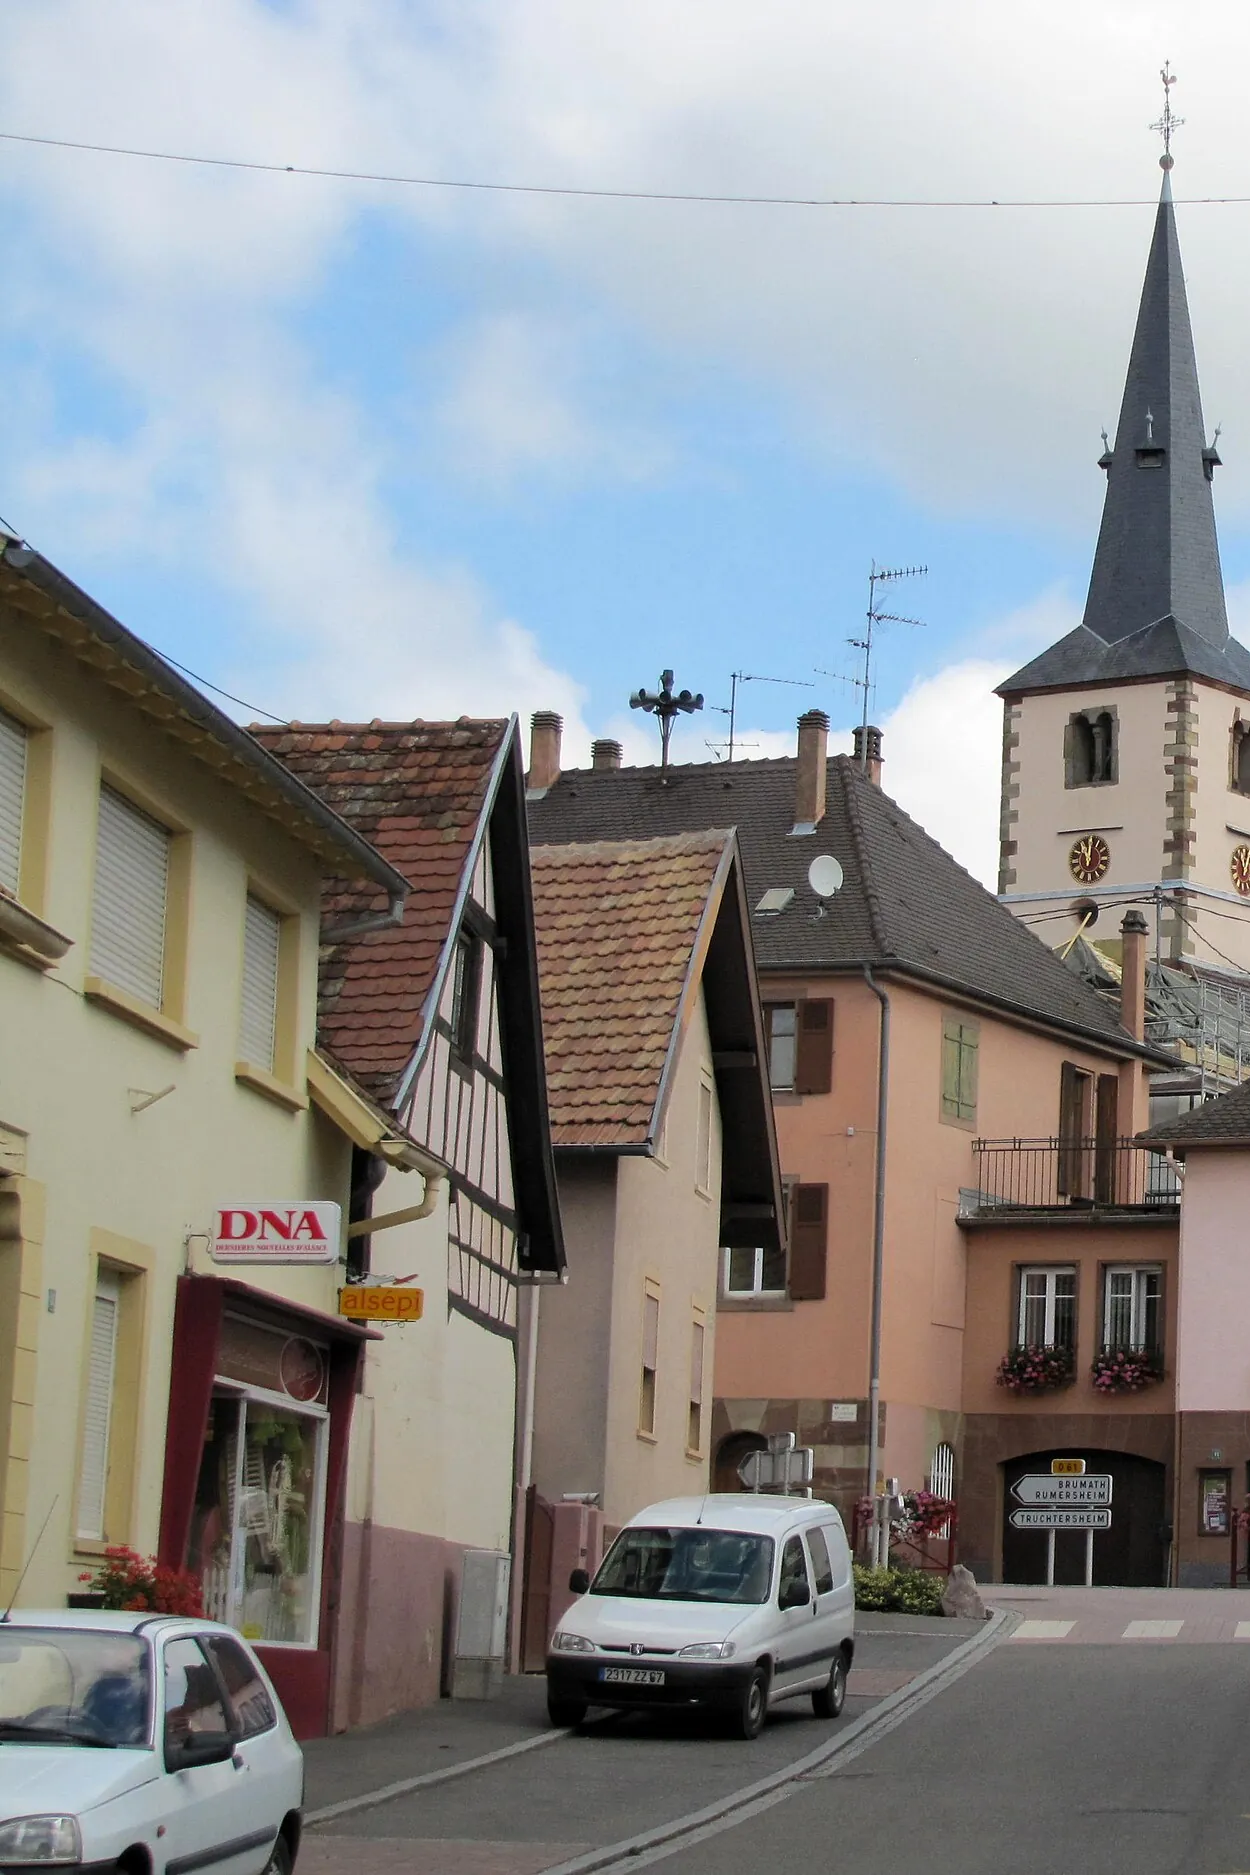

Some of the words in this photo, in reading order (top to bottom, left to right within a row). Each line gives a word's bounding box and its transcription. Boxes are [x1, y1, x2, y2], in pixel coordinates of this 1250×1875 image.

[217, 1210, 328, 1240] DNA
[344, 1288, 421, 1317] alsépi
[1058, 1480, 1106, 1489] BRUMATH
[1035, 1491, 1106, 1499] RUMERSHEIM
[1020, 1514, 1105, 1523] TRUCHTERSHEIM
[606, 1668, 632, 1681] 2317
[634, 1670, 647, 1682] ZZ
